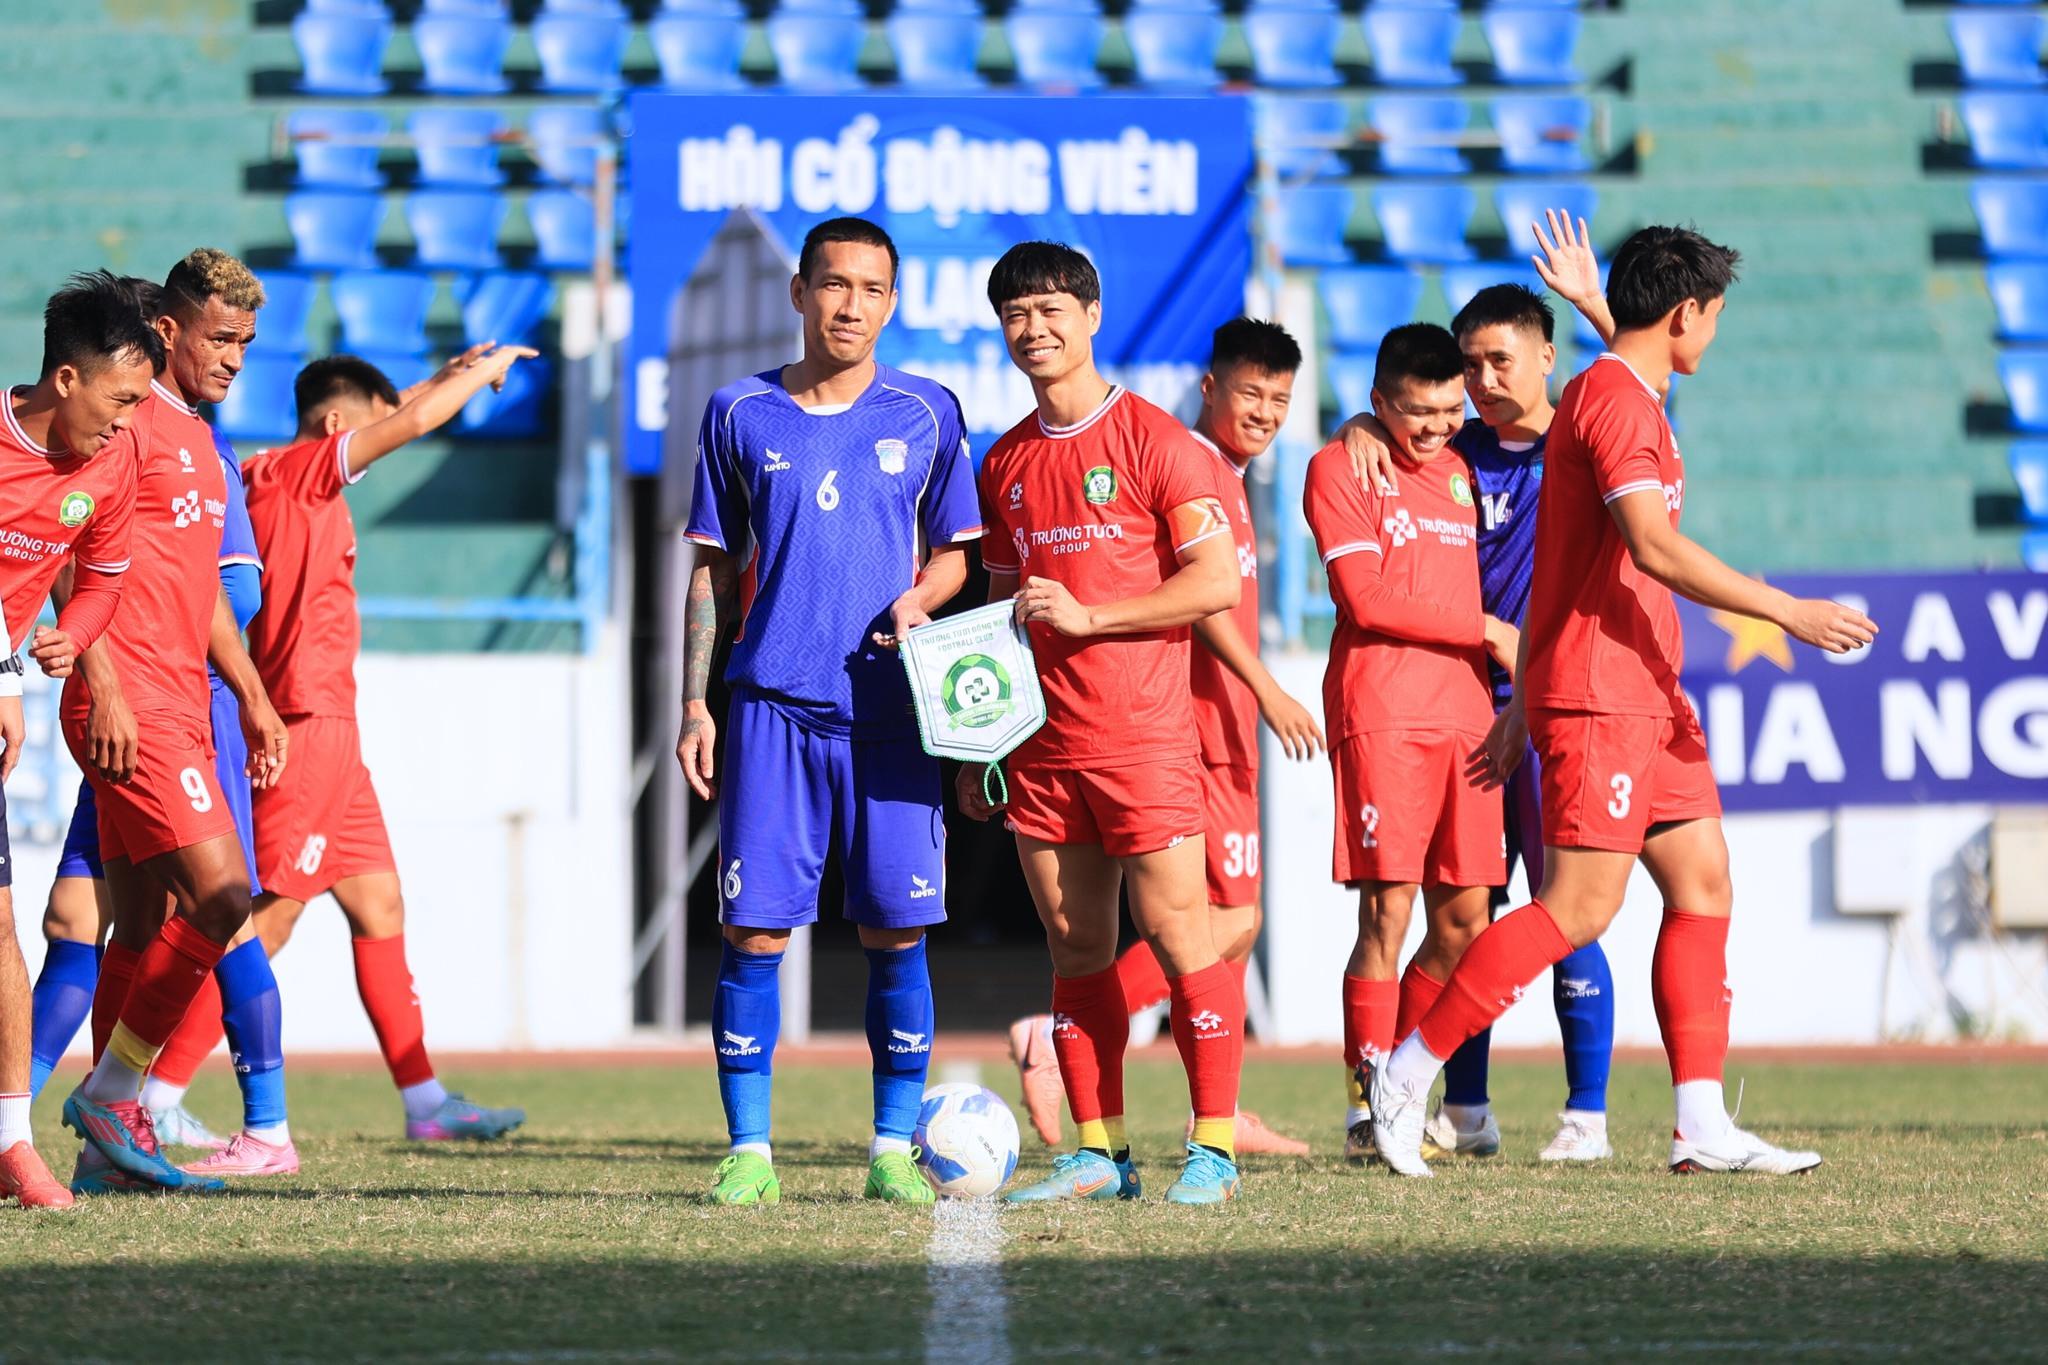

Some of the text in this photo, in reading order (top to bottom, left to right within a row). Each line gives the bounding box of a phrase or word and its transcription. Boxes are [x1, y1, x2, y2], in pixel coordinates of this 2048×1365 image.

[885, 125, 1051, 228] ĐỘNG
[1058, 125, 1197, 215] VIÊN
[816, 469, 840, 511] 6
[1481, 492, 1510, 530] 14
[4, 546, 44, 562] GROUP
[1030, 525, 1082, 546] TRƯỜNG
[1052, 541, 1091, 555] GROUP
[1686, 680, 1847, 786] IA
[179, 767, 213, 813] 9
[1608, 773, 1633, 819] 3
[1361, 804, 1380, 849] 2
[1223, 832, 1259, 878] 30
[724, 858, 742, 899] 6
[910, 888, 937, 899] KAMITO
[719, 1045, 762, 1057] KAMITO
